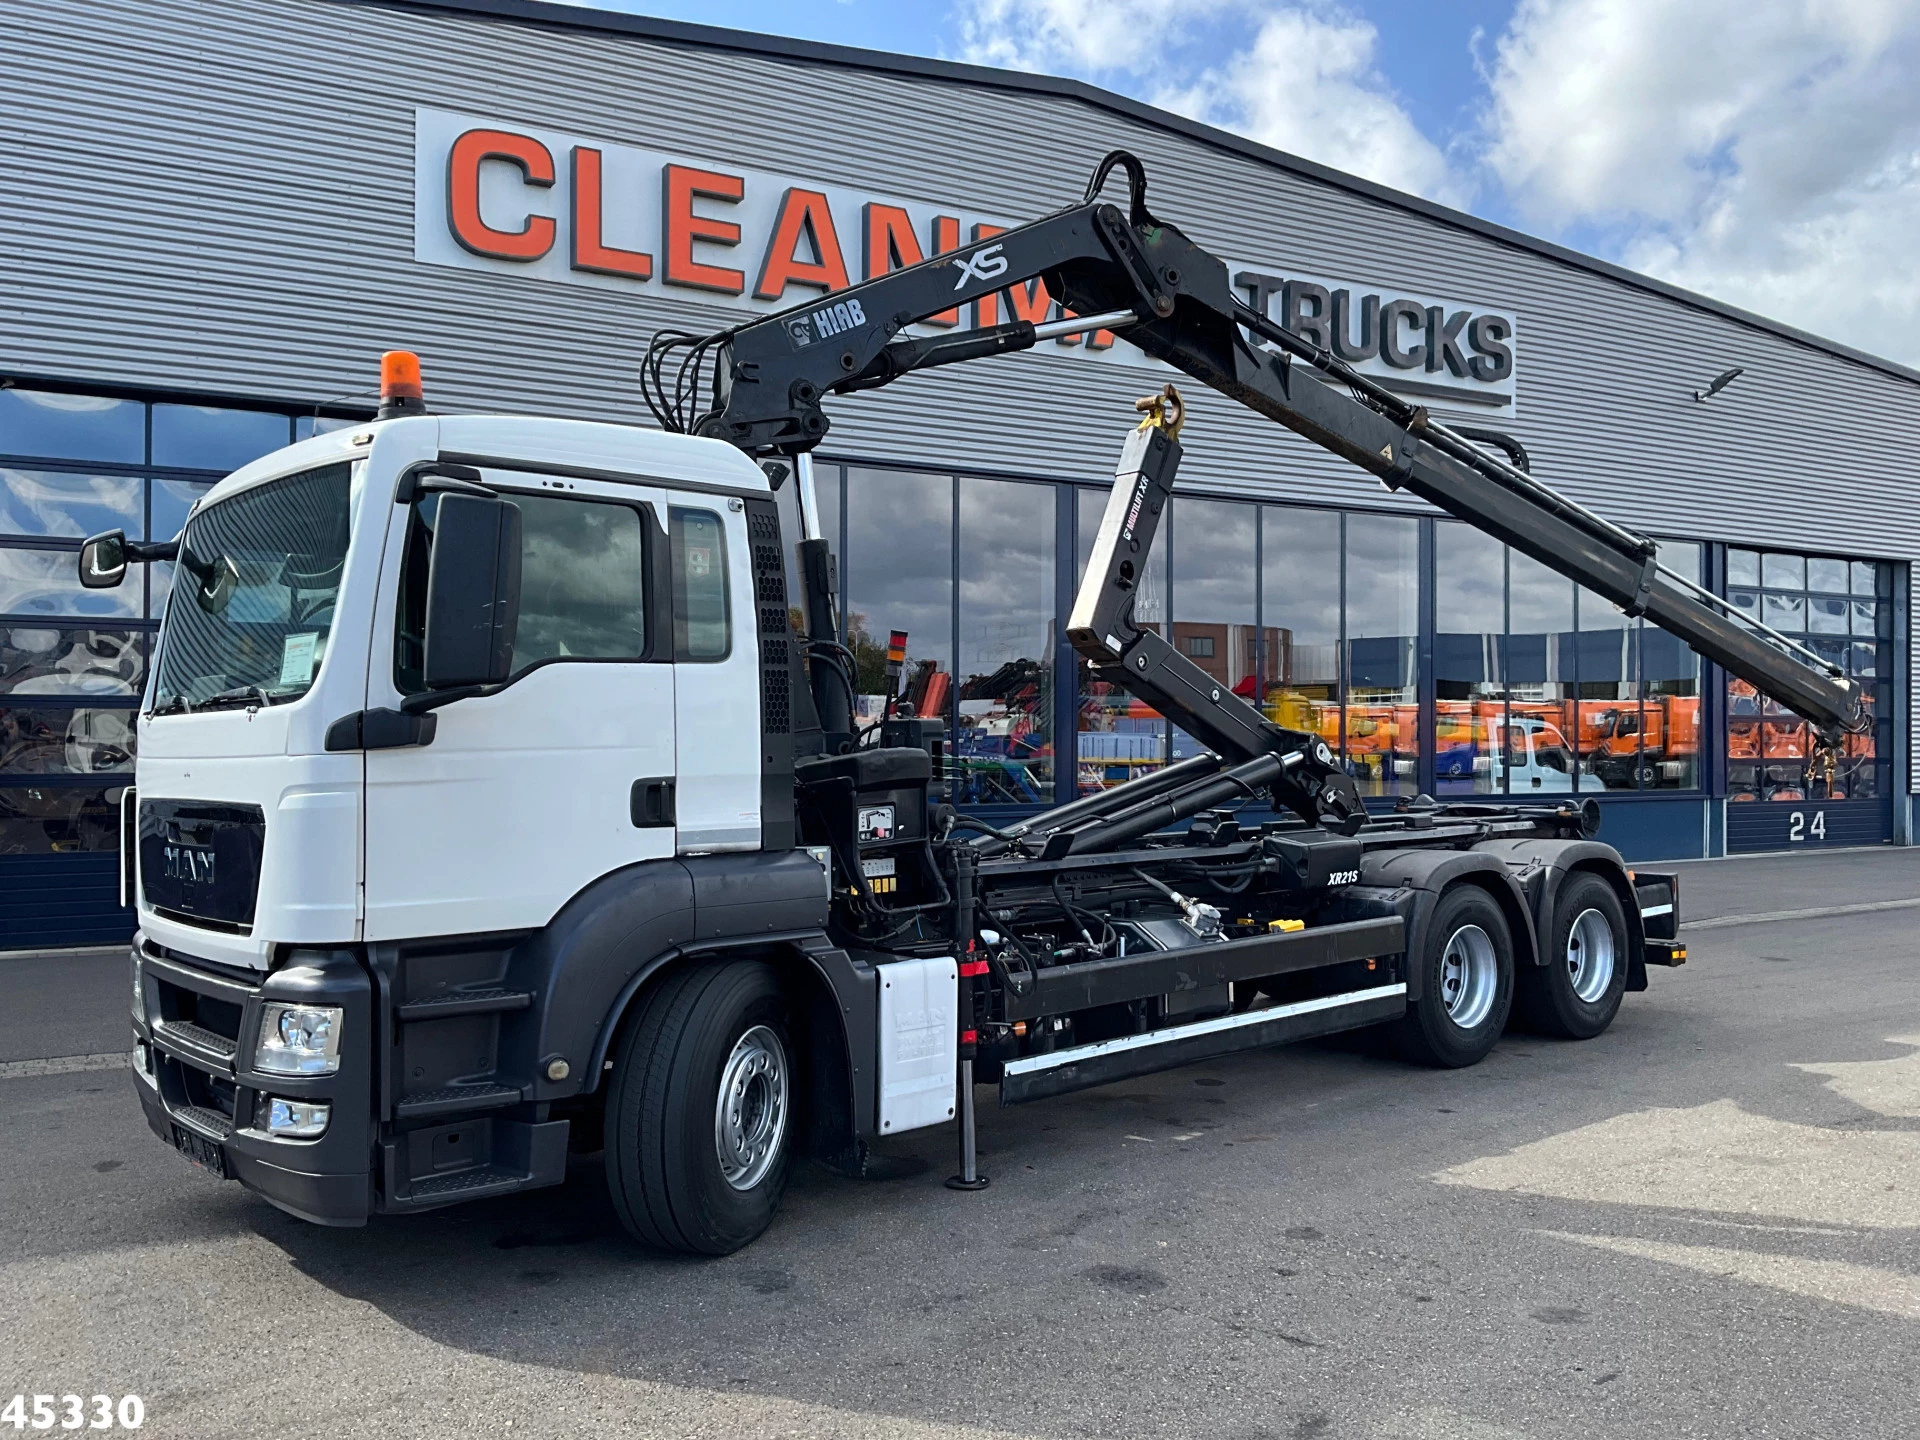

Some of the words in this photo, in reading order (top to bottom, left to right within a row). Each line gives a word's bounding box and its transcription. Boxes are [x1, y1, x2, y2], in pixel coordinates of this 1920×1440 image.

[952, 243, 1008, 291] XS
[812, 298, 867, 339] HIAB
[1214, 271, 1512, 382] TRUCKS
[1790, 811, 1826, 841] 24
[163, 846, 215, 884] MAN
[1327, 869, 1359, 886] XR21S
